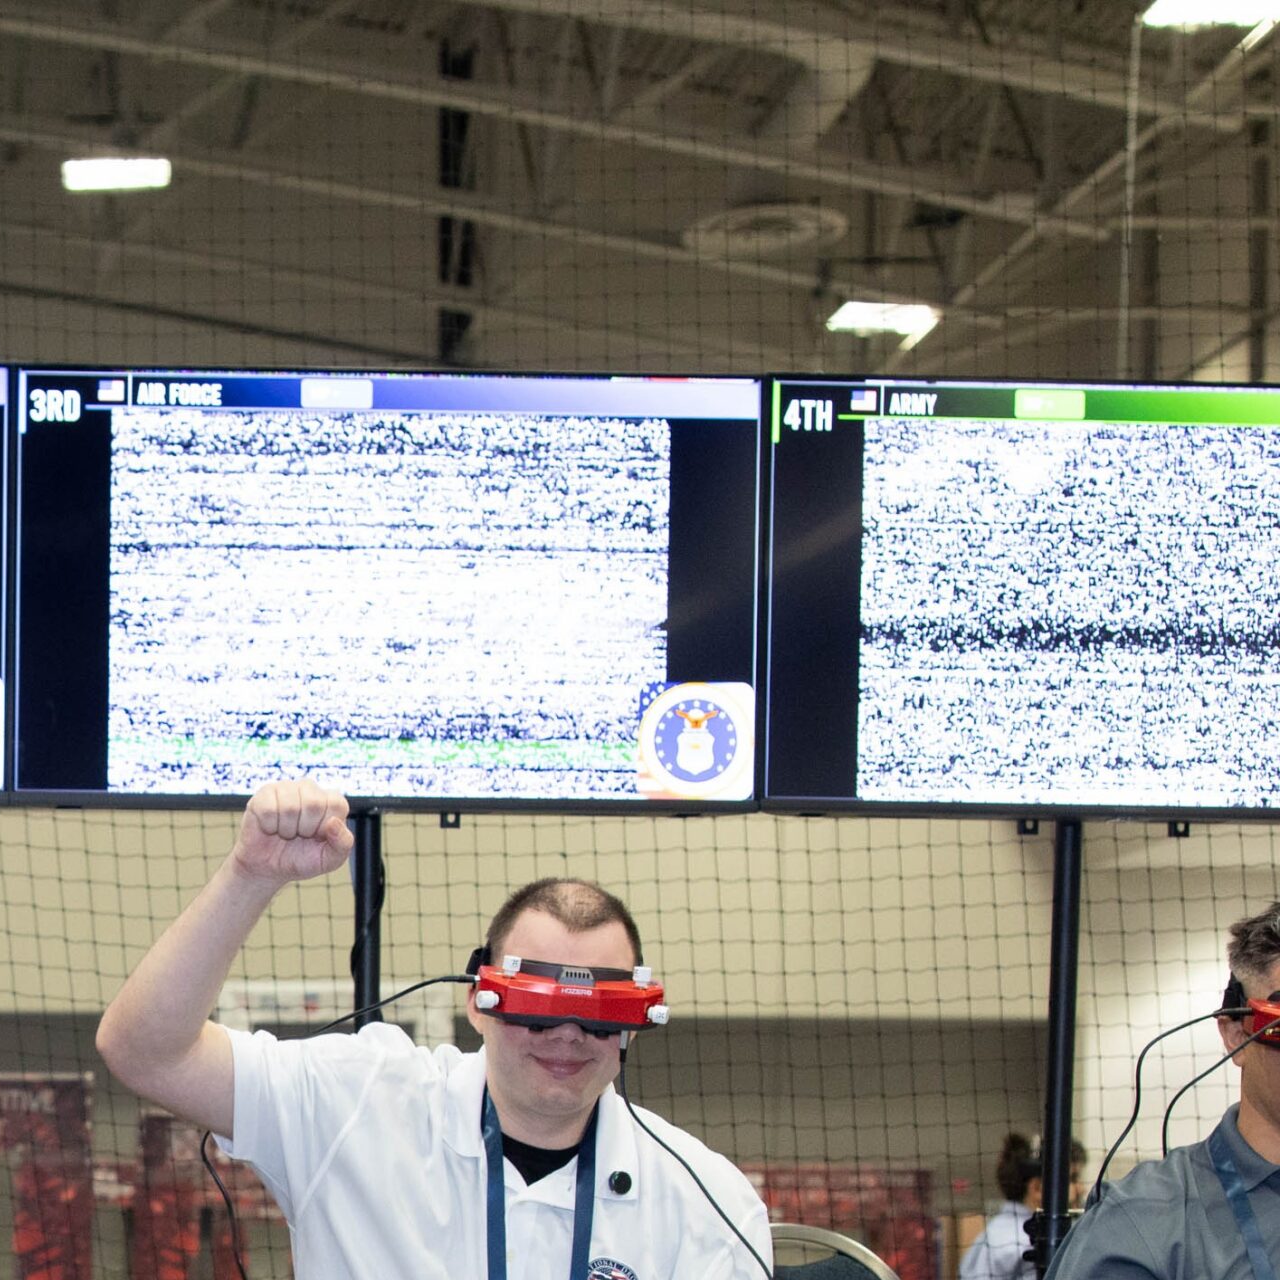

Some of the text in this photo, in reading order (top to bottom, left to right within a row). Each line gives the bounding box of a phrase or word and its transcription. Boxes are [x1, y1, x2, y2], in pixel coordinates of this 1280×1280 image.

[29, 382, 222, 422] 3RD AIR FORCE
[783, 393, 937, 431] 4TH ARMY
[588, 1260, 617, 1273] ATIONAL
